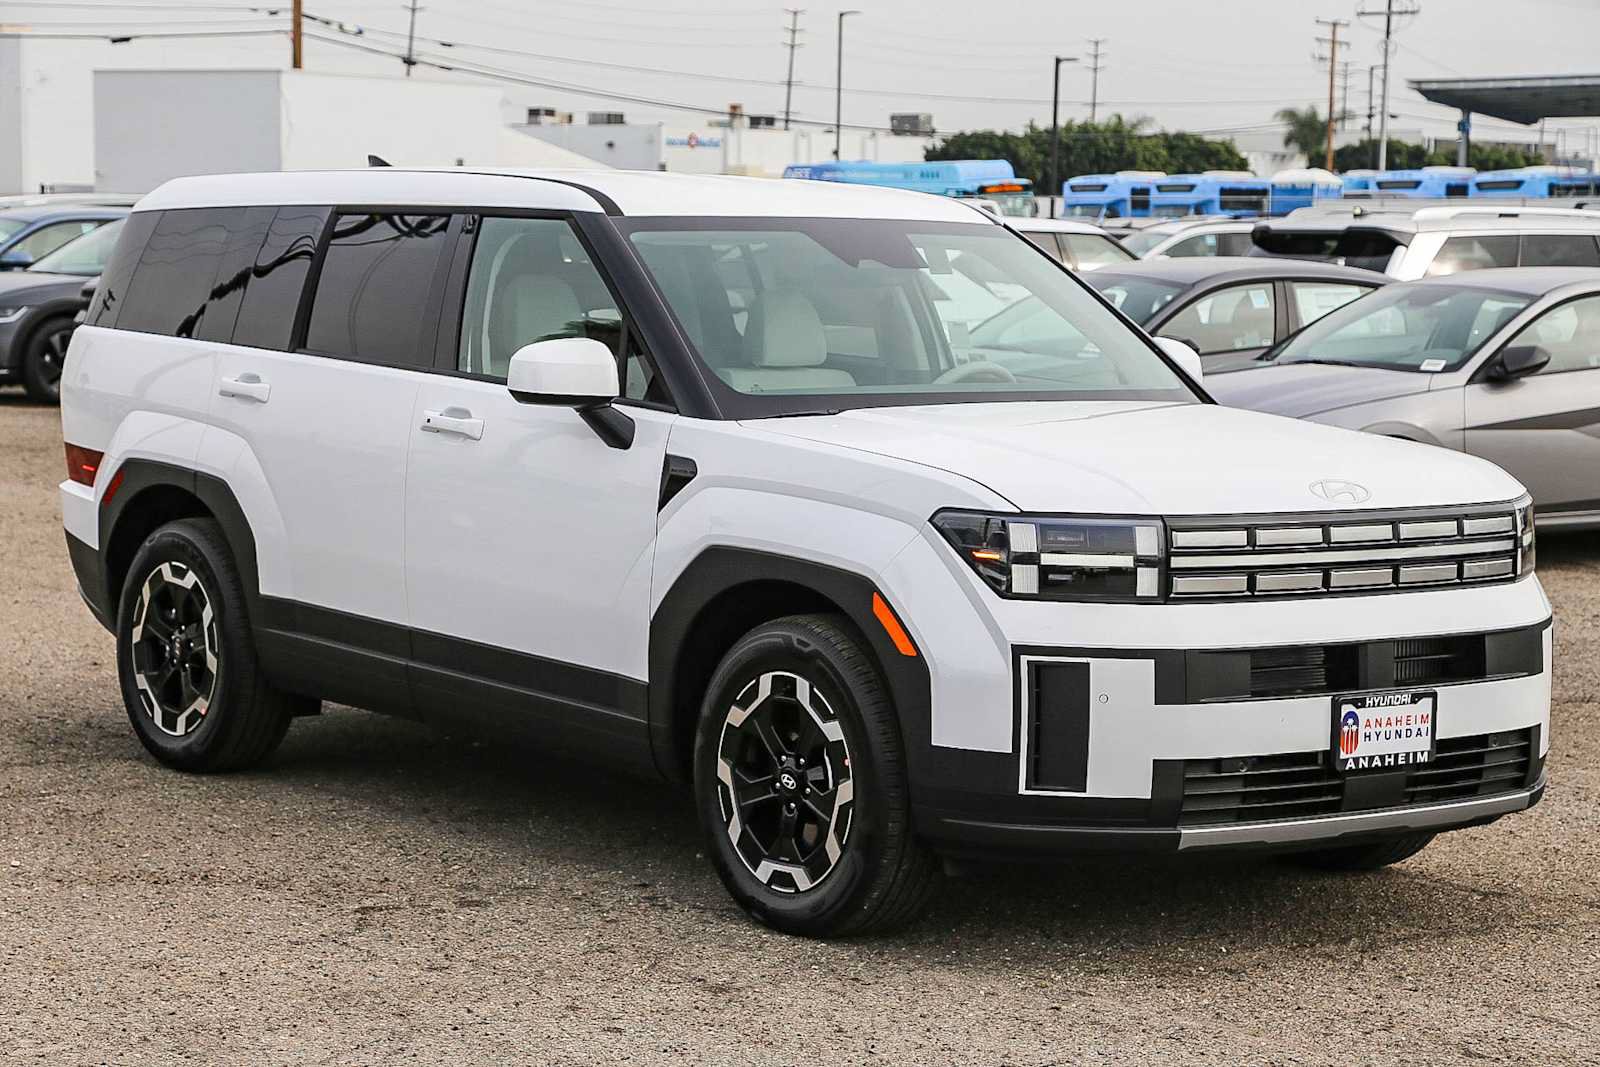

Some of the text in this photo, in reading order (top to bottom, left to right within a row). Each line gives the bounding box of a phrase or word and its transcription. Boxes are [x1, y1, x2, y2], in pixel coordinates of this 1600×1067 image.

[1365, 694, 1412, 708] HYUNDAI
[1364, 714, 1429, 729] ANAHEIM
[1364, 727, 1429, 742] HYUNDAI
[1345, 751, 1429, 770] ANAHEIM
